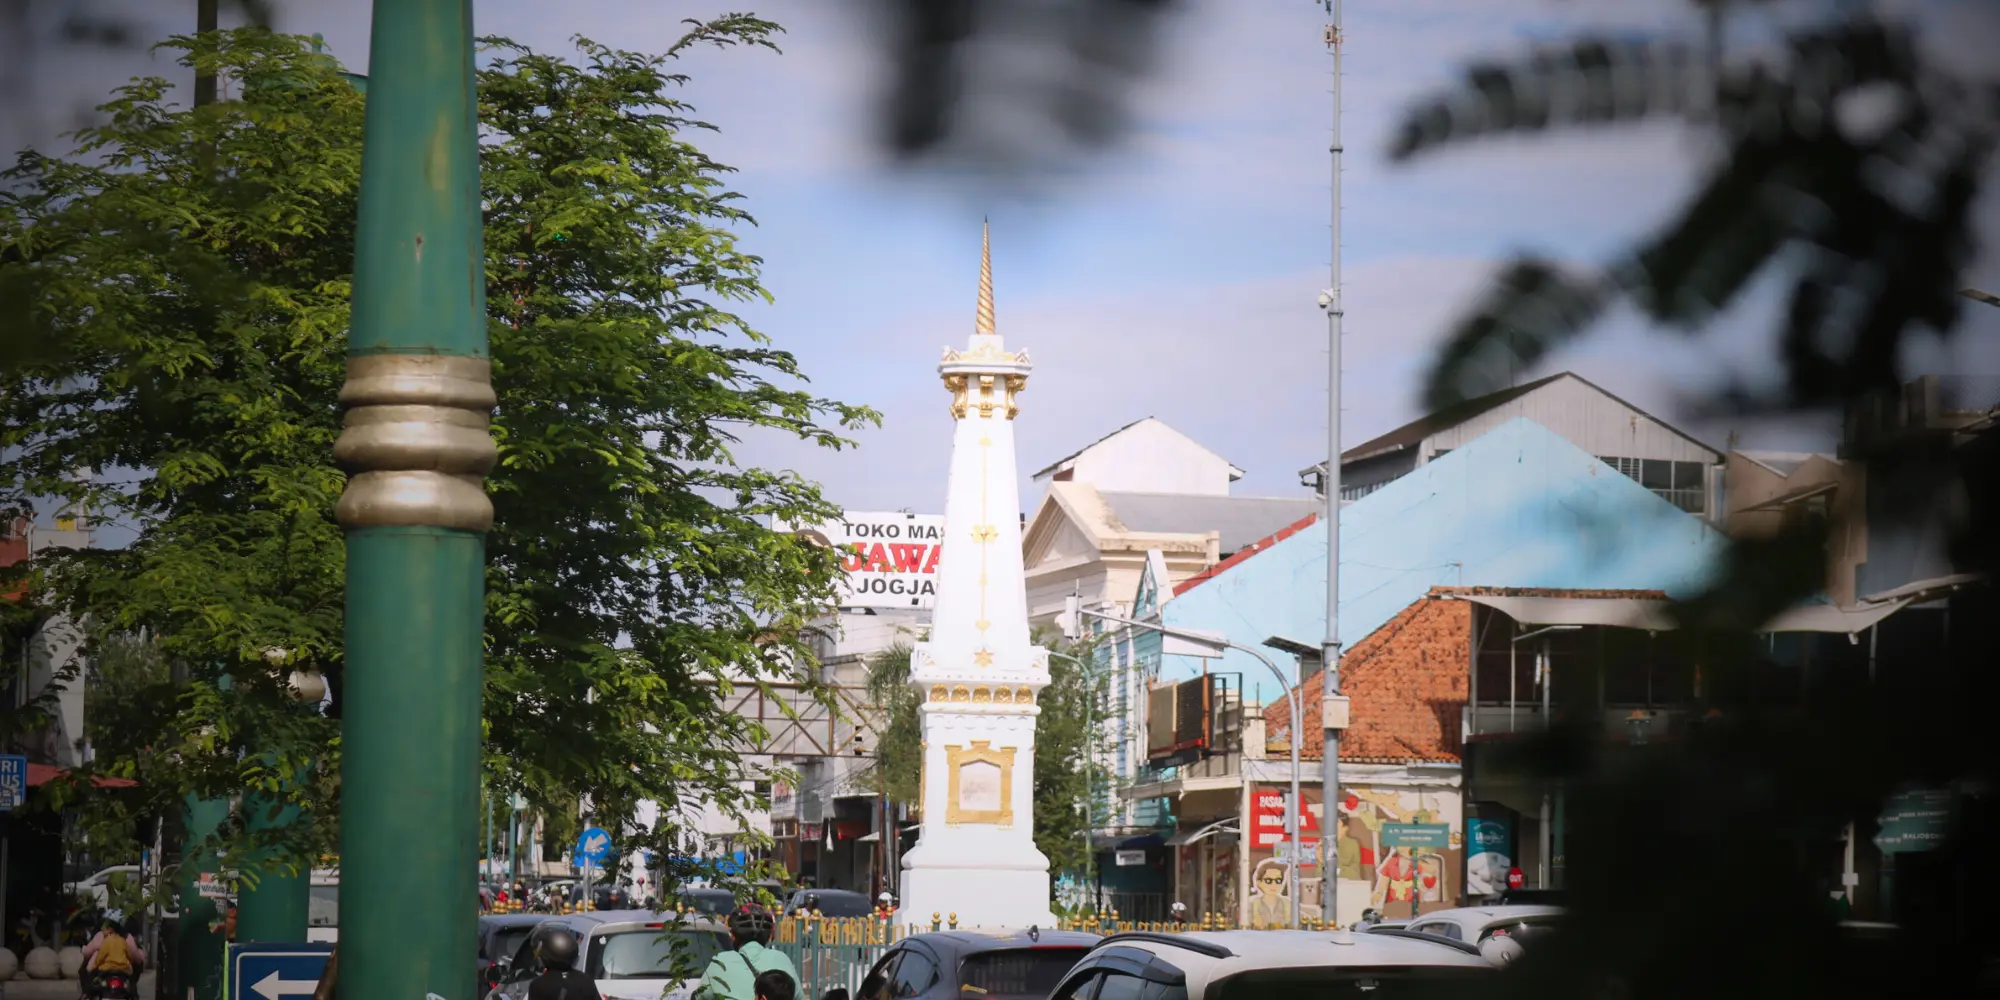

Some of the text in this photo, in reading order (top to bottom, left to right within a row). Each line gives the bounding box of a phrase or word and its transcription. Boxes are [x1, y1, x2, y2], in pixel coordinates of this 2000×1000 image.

[842, 523, 900, 538] TOKO
[841, 542, 941, 574] JAWA
[856, 578, 935, 595] JOGJA
